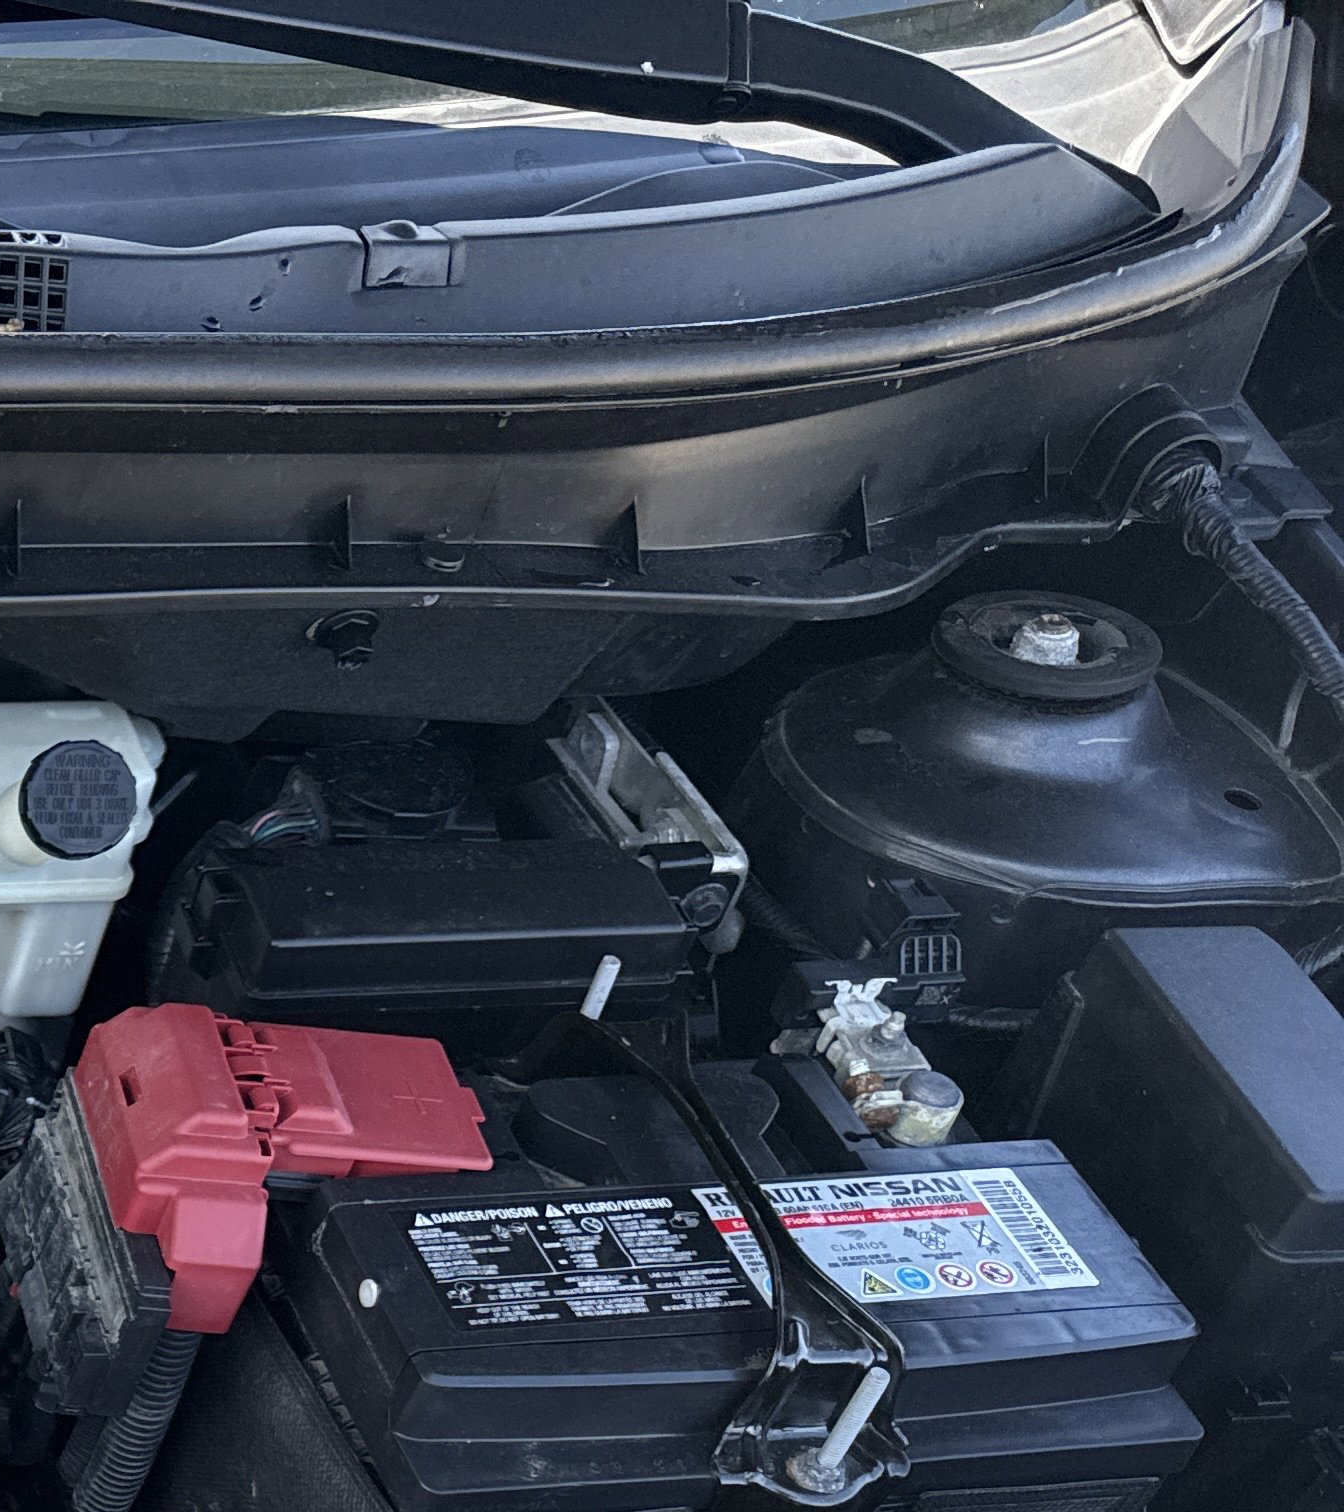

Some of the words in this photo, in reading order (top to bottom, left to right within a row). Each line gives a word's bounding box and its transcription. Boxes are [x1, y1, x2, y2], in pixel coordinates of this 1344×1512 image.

[828, 1176, 962, 1200] NISSAN
[430, 1206, 539, 1224] DANGER/POISON
[562, 1197, 673, 1215] PELIGRO/VENENO
[828, 1212, 865, 1225] Battery
[874, 1209, 910, 1222] Special
[911, 1205, 969, 1219] technology
[830, 1241, 888, 1252] CLARIOS
